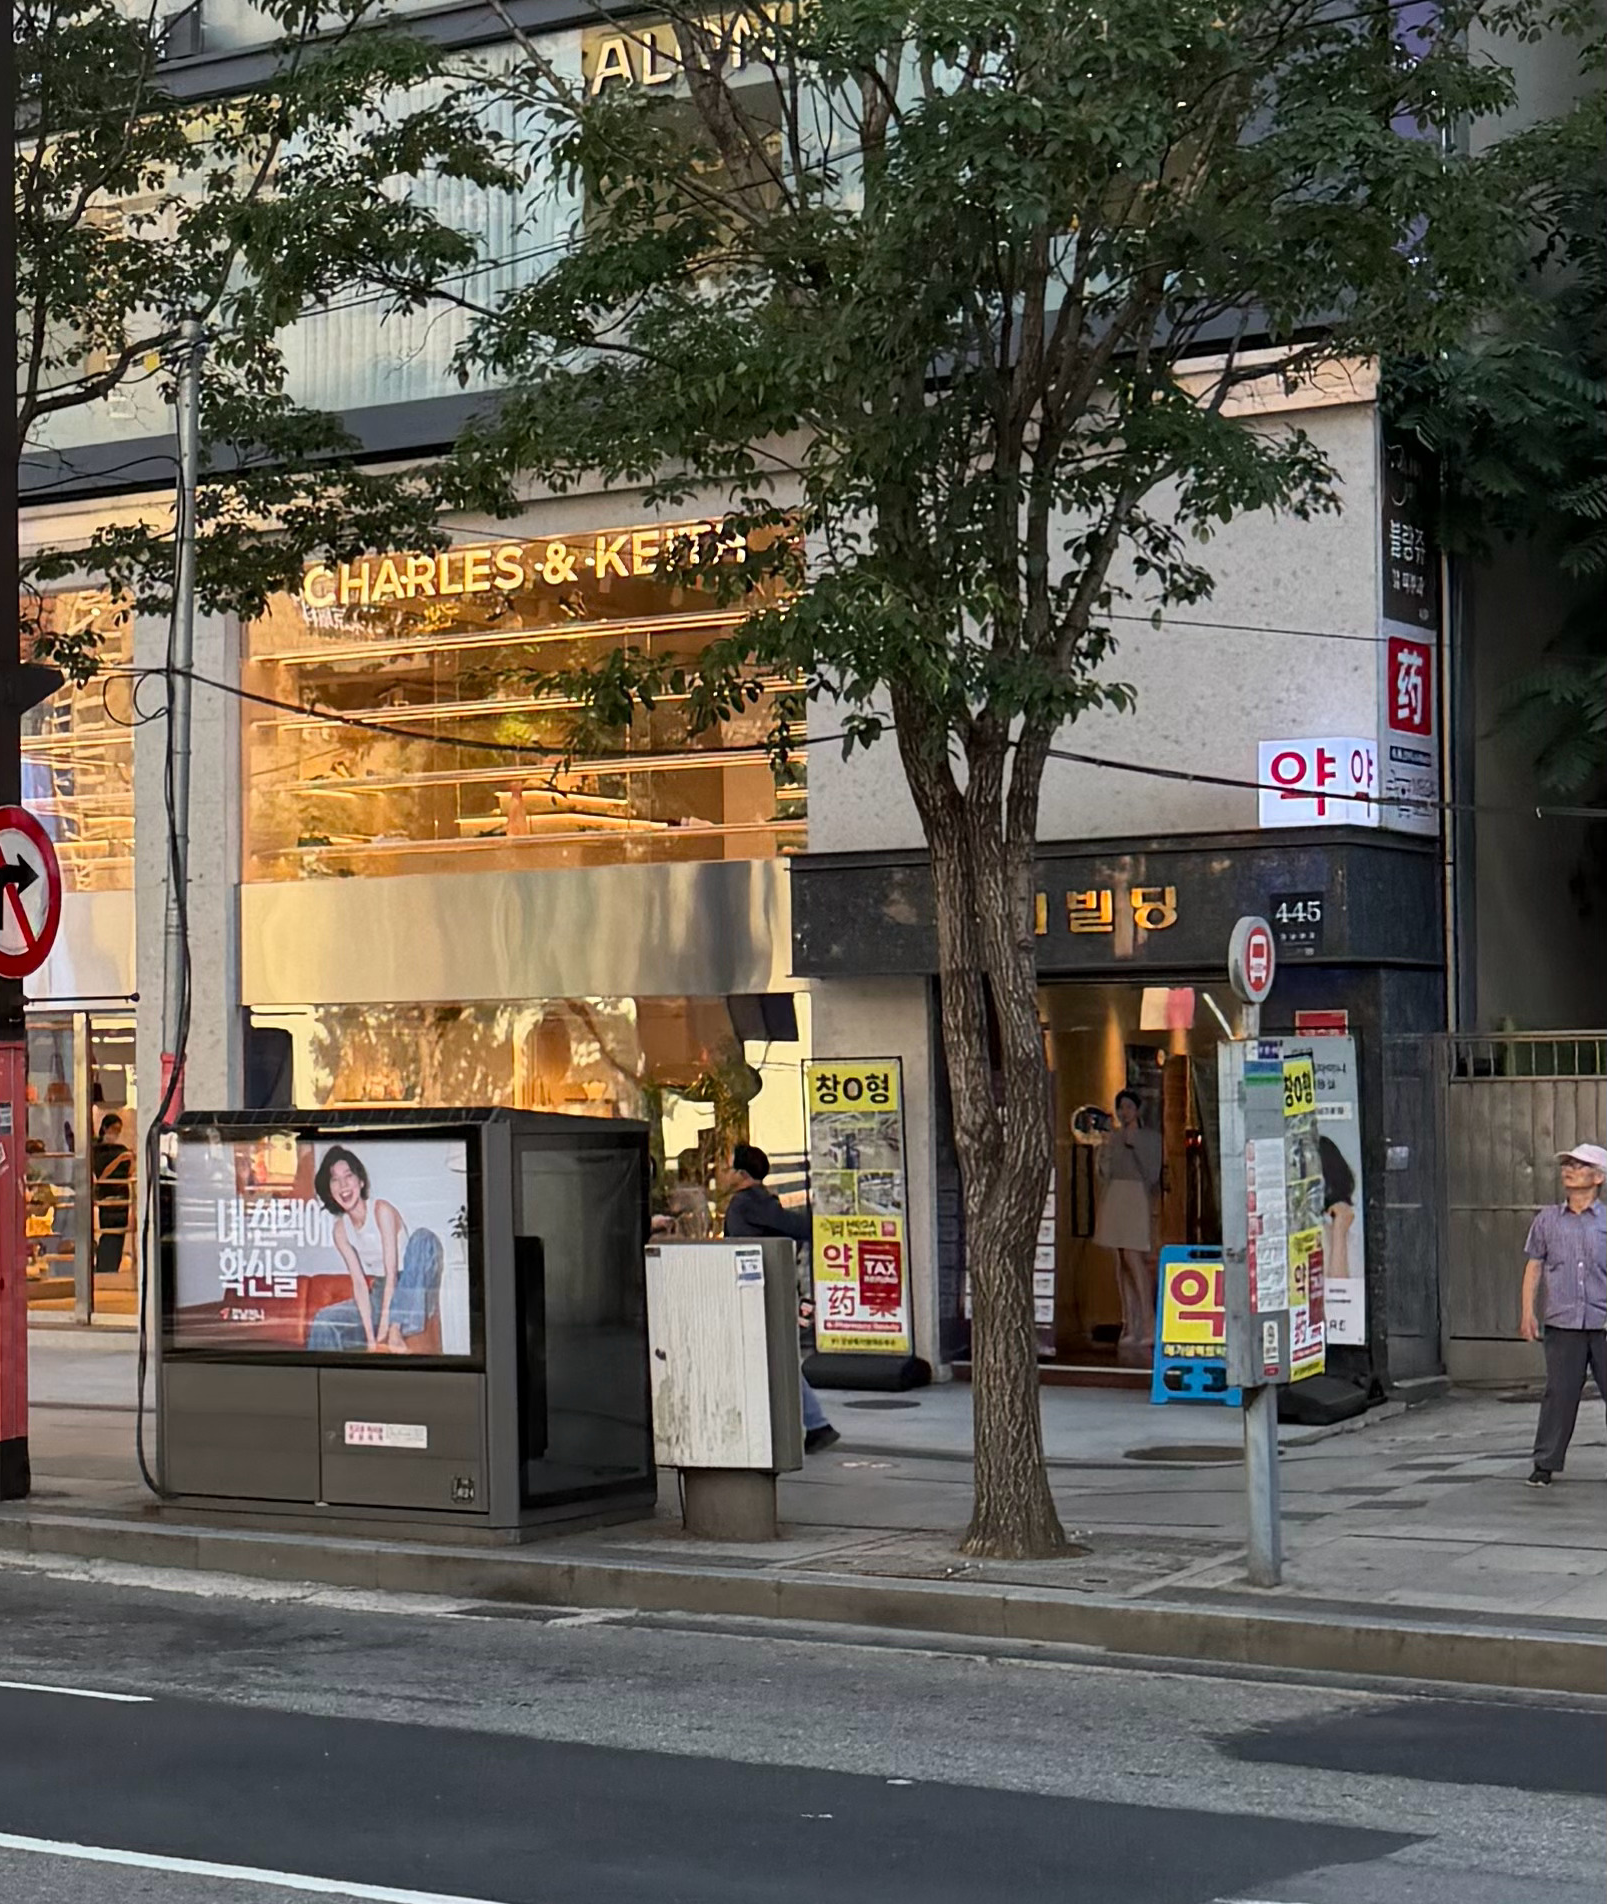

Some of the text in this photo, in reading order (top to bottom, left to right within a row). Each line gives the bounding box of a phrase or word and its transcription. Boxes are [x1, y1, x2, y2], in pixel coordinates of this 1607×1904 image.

[303, 546, 523, 607] CHARLES
[543, 543, 577, 584] &
[1271, 748, 1336, 816] 약
[1035, 886, 1177, 934] 빌딩
[1275, 900, 1321, 923] 445
[218, 1198, 245, 1247] 내
[219, 1248, 298, 1298] 확신을
[823, 1243, 853, 1277] 약
[864, 1260, 897, 1275] TAX
[827, 1285, 855, 1317] 药
